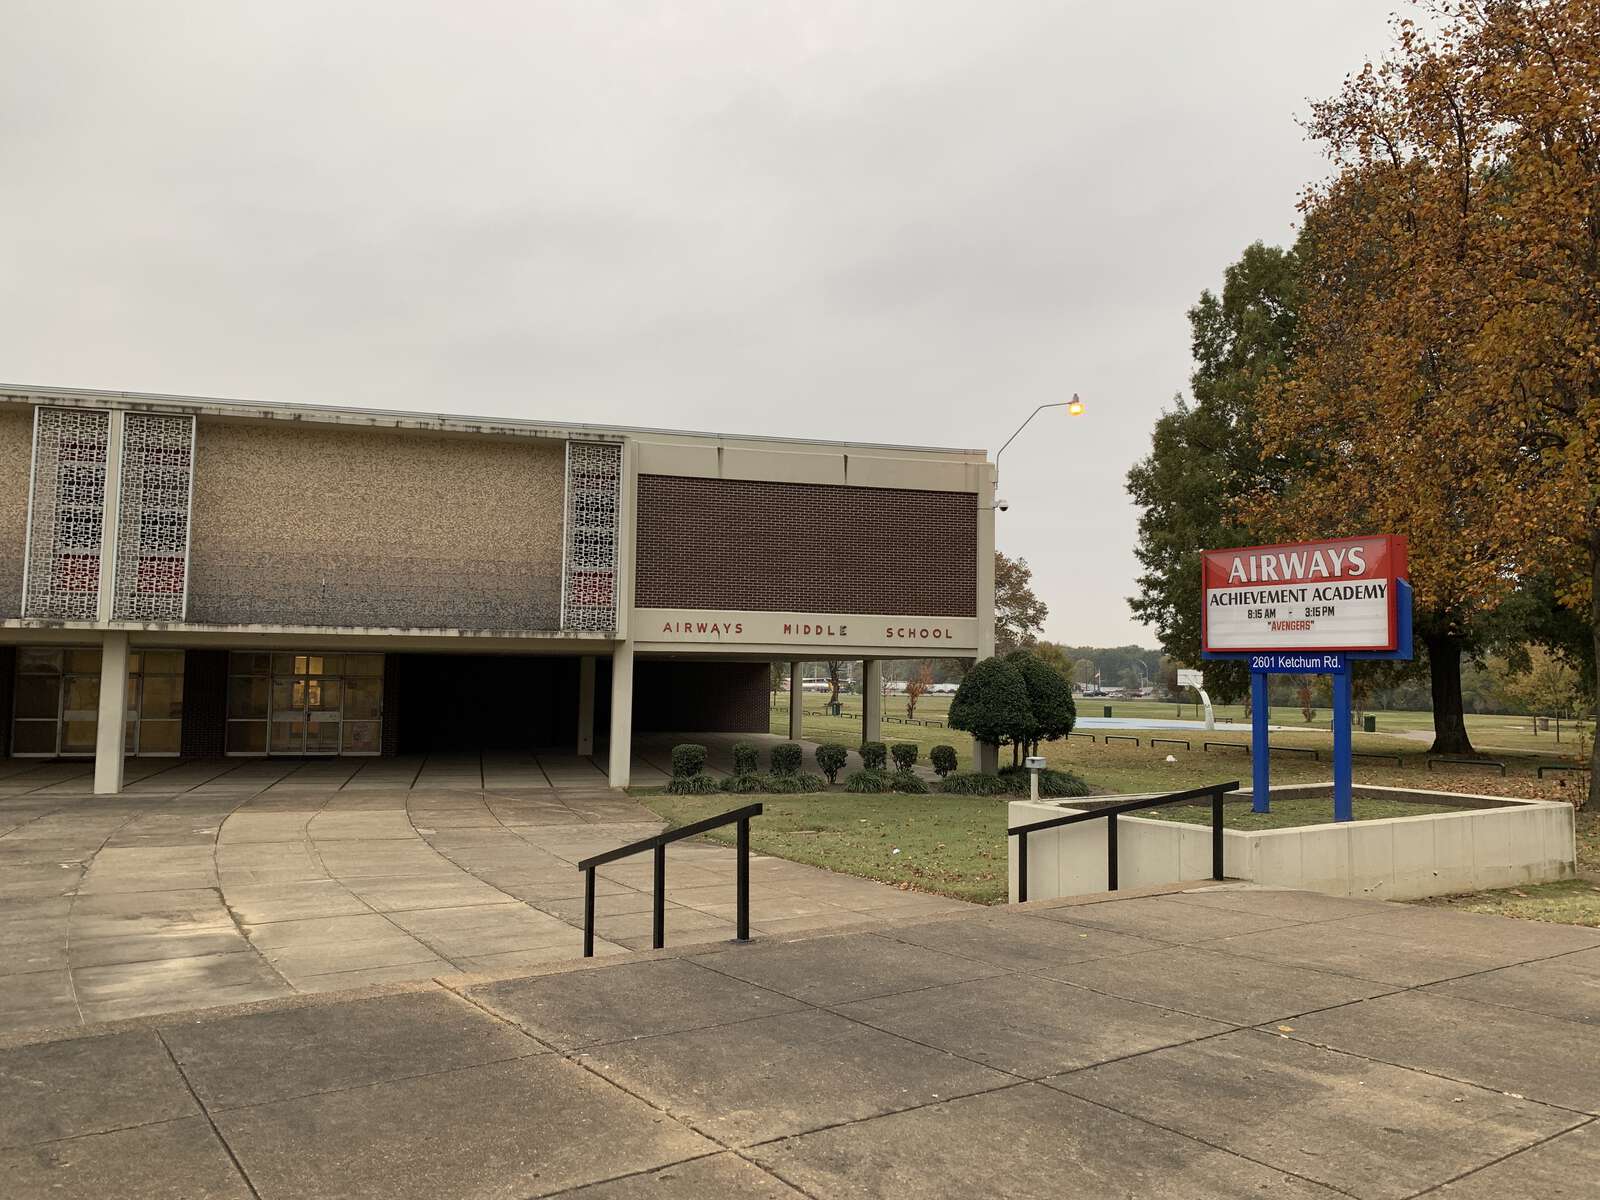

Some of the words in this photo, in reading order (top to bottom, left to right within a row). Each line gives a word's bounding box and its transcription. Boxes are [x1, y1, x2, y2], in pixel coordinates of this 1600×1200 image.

[1228, 546, 1366, 584] AIRWAYS
[1210, 588, 1308, 607] ACHIEVEMENT
[1312, 584, 1387, 601] ACADEMY
[1247, 609, 1262, 619] 8:15
[1264, 609, 1276, 618] AM
[1305, 607, 1321, 617] 3:15
[1322, 607, 1335, 617] PM
[663, 622, 743, 634] AIRWAYS
[783, 623, 847, 636] MIDDLE
[886, 627, 952, 639] SCHOOL
[1267, 620, 1315, 631] "AVENGERS"
[1252, 656, 1275, 669] 2601
[1278, 655, 1321, 668] Ketchum
[1323, 656, 1341, 668] Rd.
